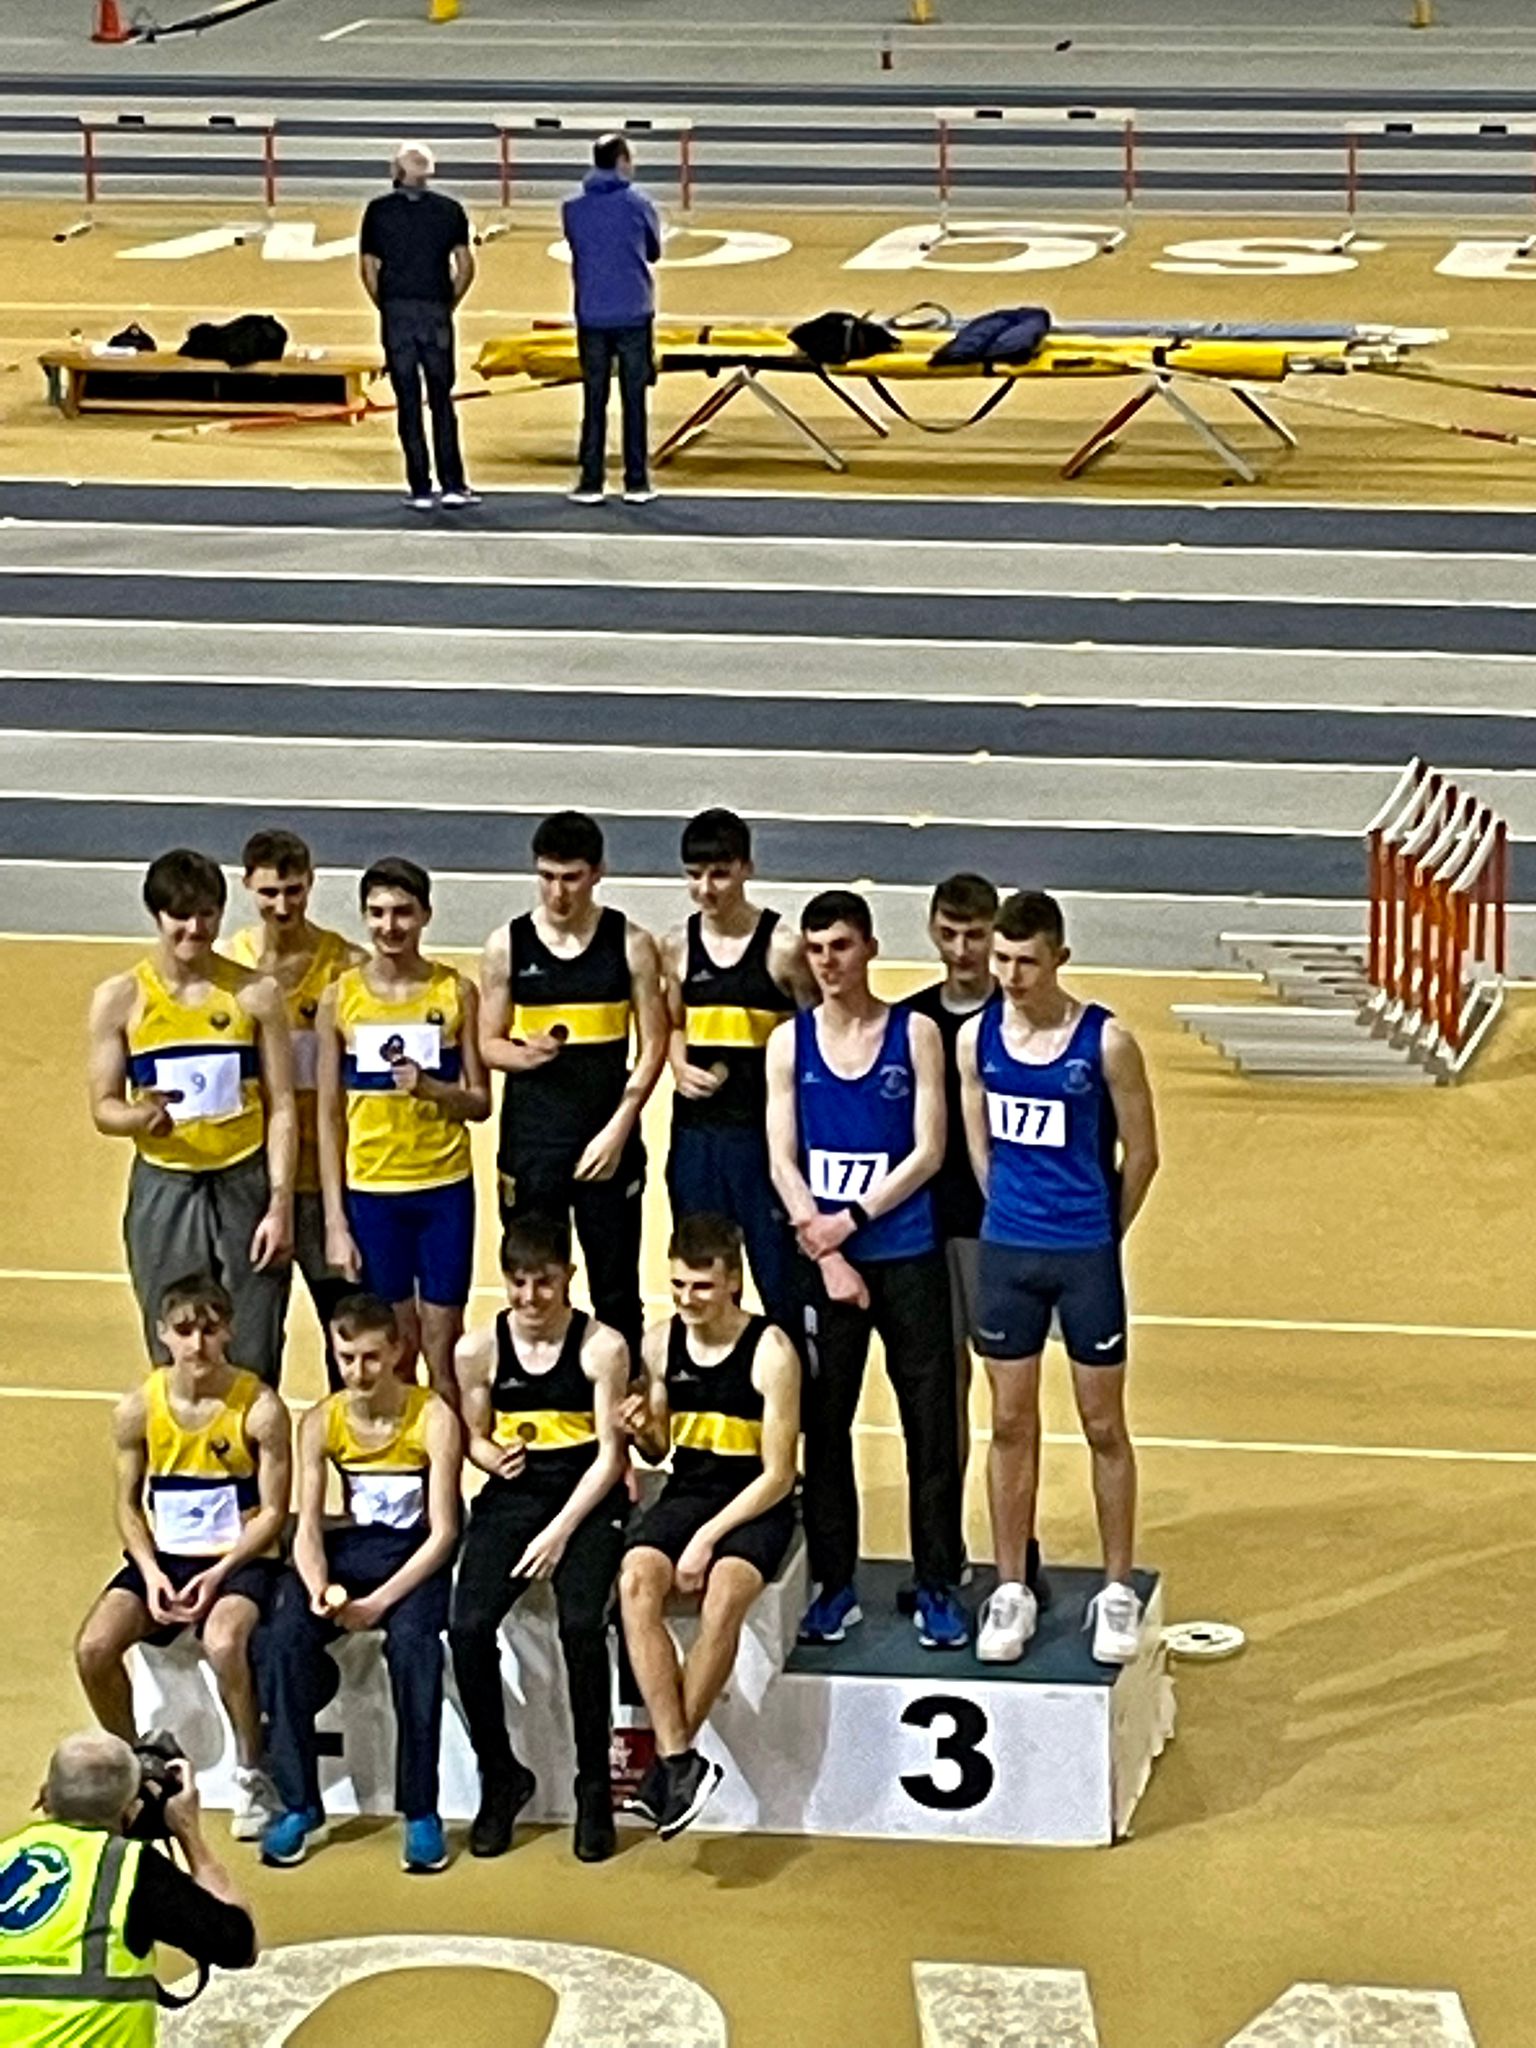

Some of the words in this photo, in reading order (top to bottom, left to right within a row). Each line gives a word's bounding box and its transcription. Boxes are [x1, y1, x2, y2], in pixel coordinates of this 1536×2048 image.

[190, 1071, 206, 1095] 9
[1001, 1100, 1051, 1139] 177
[823, 1158, 877, 1195] 177
[900, 1694, 994, 1811] 3
